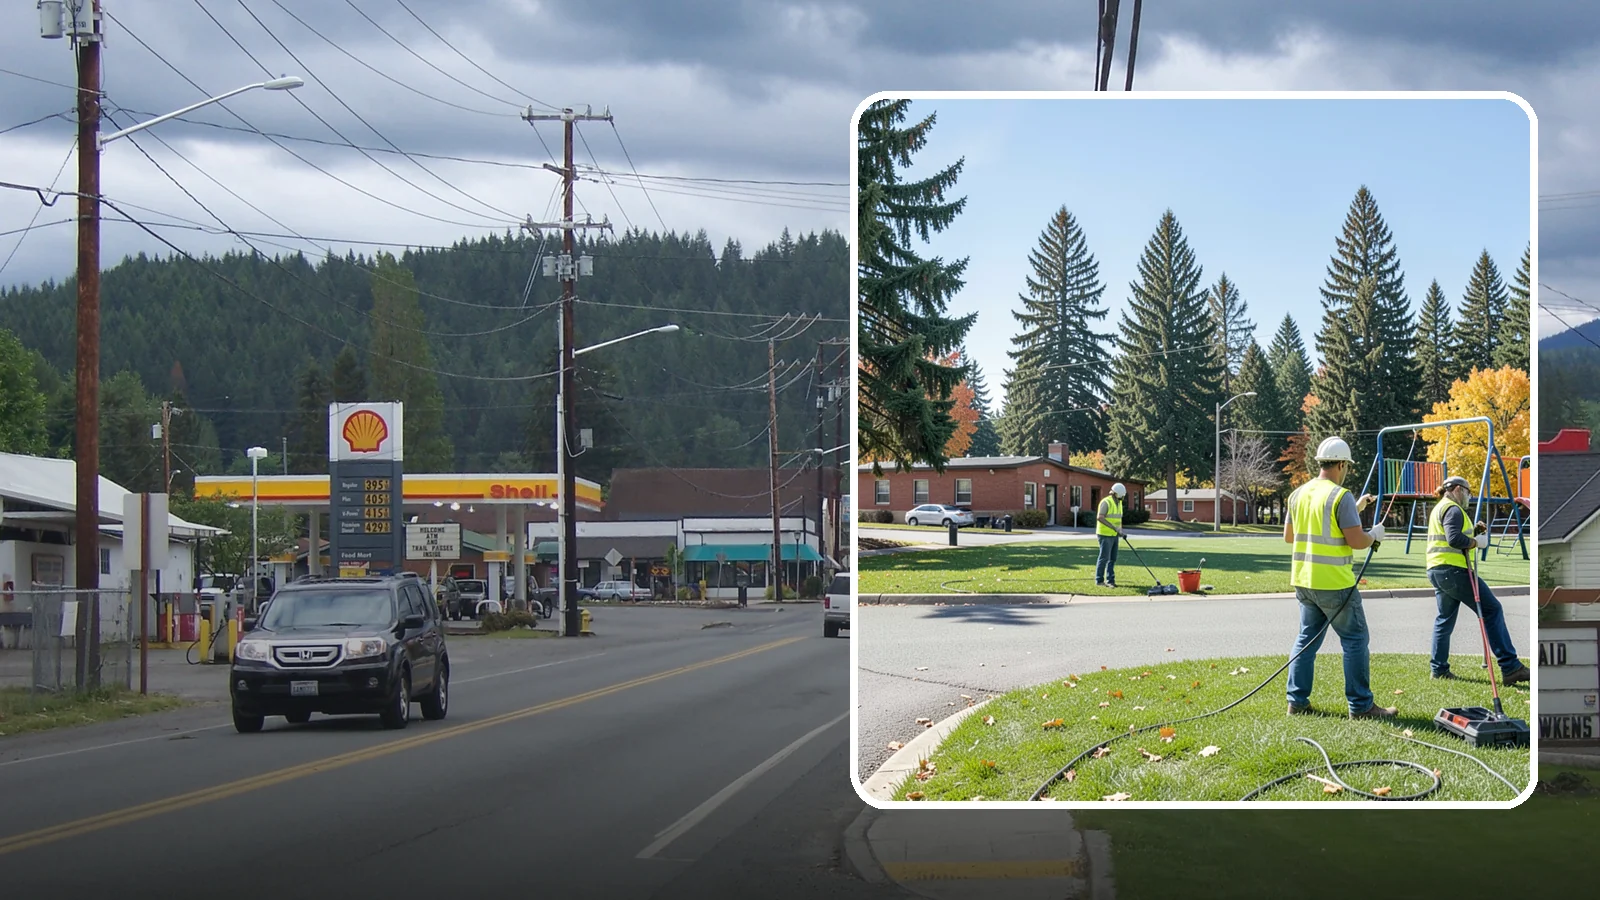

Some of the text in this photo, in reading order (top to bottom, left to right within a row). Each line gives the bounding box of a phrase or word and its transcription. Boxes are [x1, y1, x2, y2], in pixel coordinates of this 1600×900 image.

[365, 480, 384, 491] 395
[490, 484, 547, 499] Shell
[365, 494, 383, 504] 405
[365, 508, 383, 518] 415
[365, 522, 383, 533] 429
[1539, 642, 1567, 665] AID
